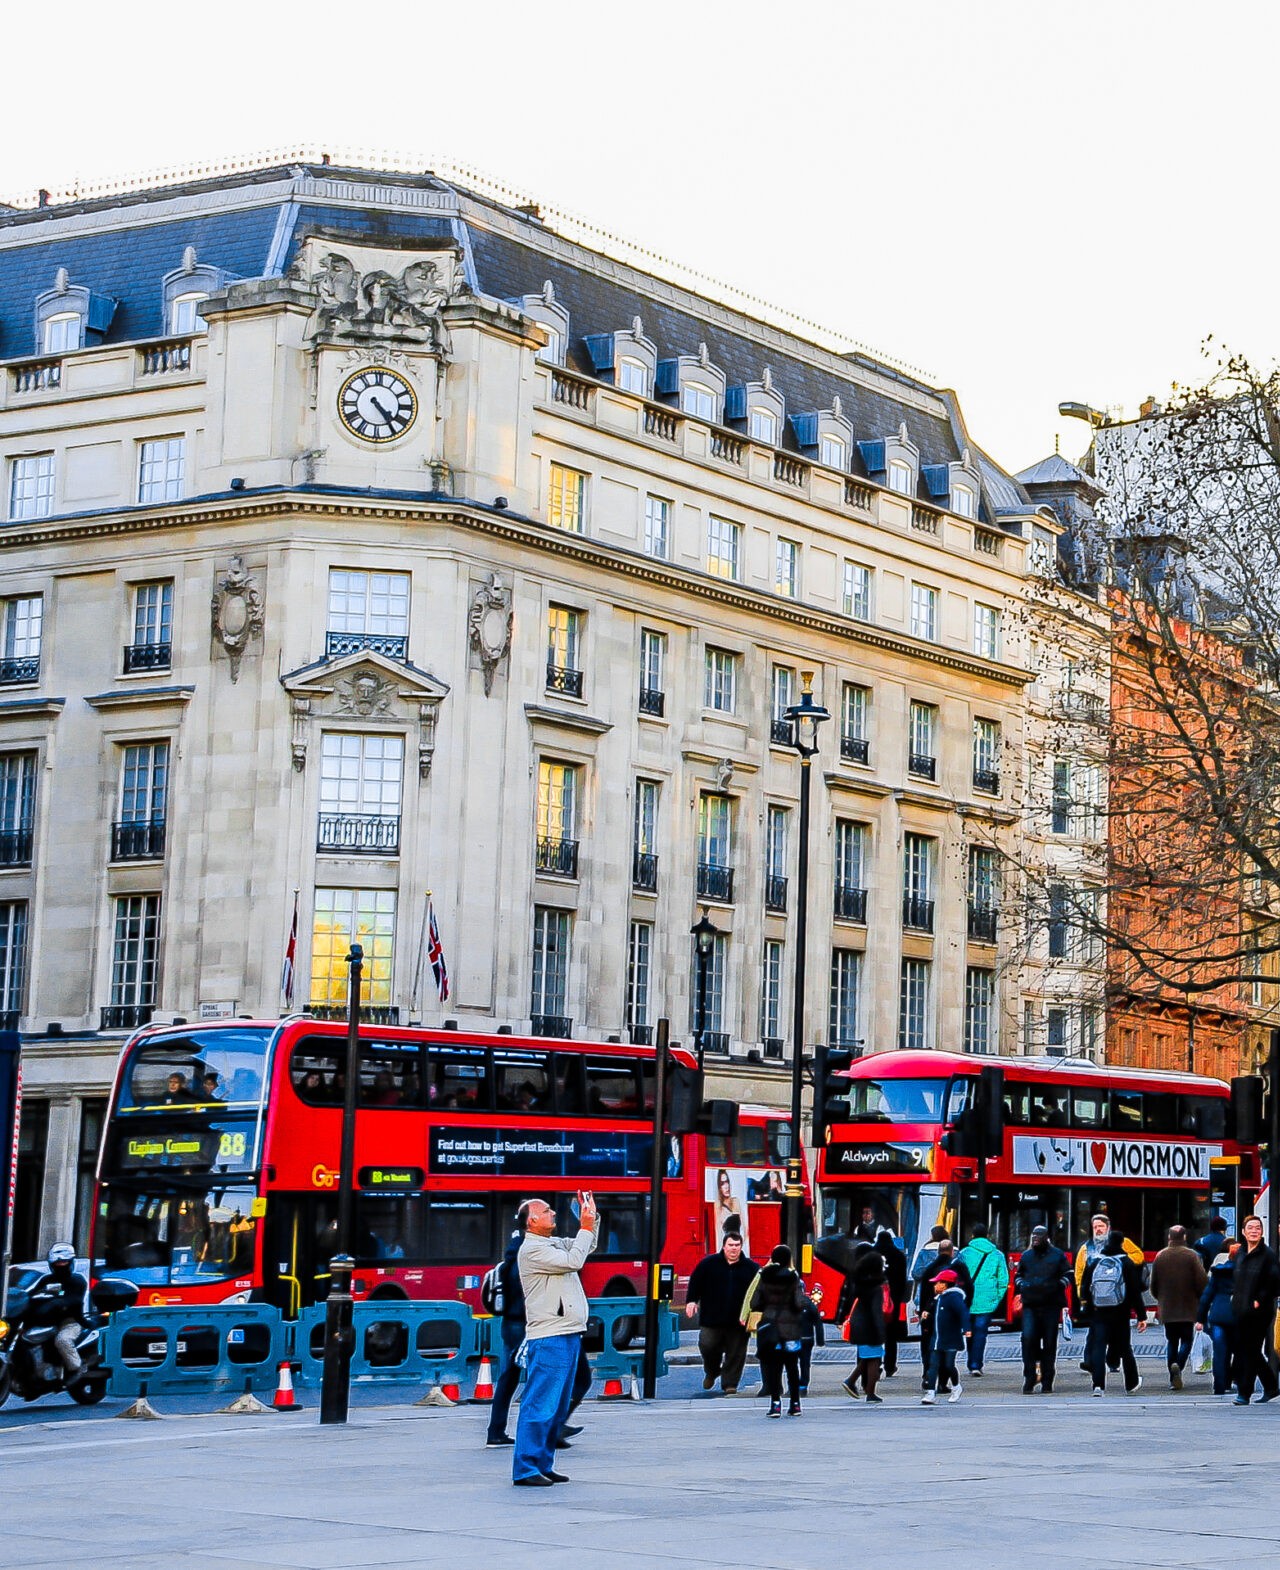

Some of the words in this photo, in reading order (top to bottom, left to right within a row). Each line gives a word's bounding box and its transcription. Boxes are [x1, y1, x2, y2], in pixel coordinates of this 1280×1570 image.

[220, 1133, 246, 1157] 88
[438, 1139, 454, 1150] Find
[455, 1141, 467, 1150] out
[483, 1141, 491, 1151] to
[492, 1142, 504, 1153] get
[841, 1150, 890, 1165] Aldwych
[911, 1148, 923, 1167] 9
